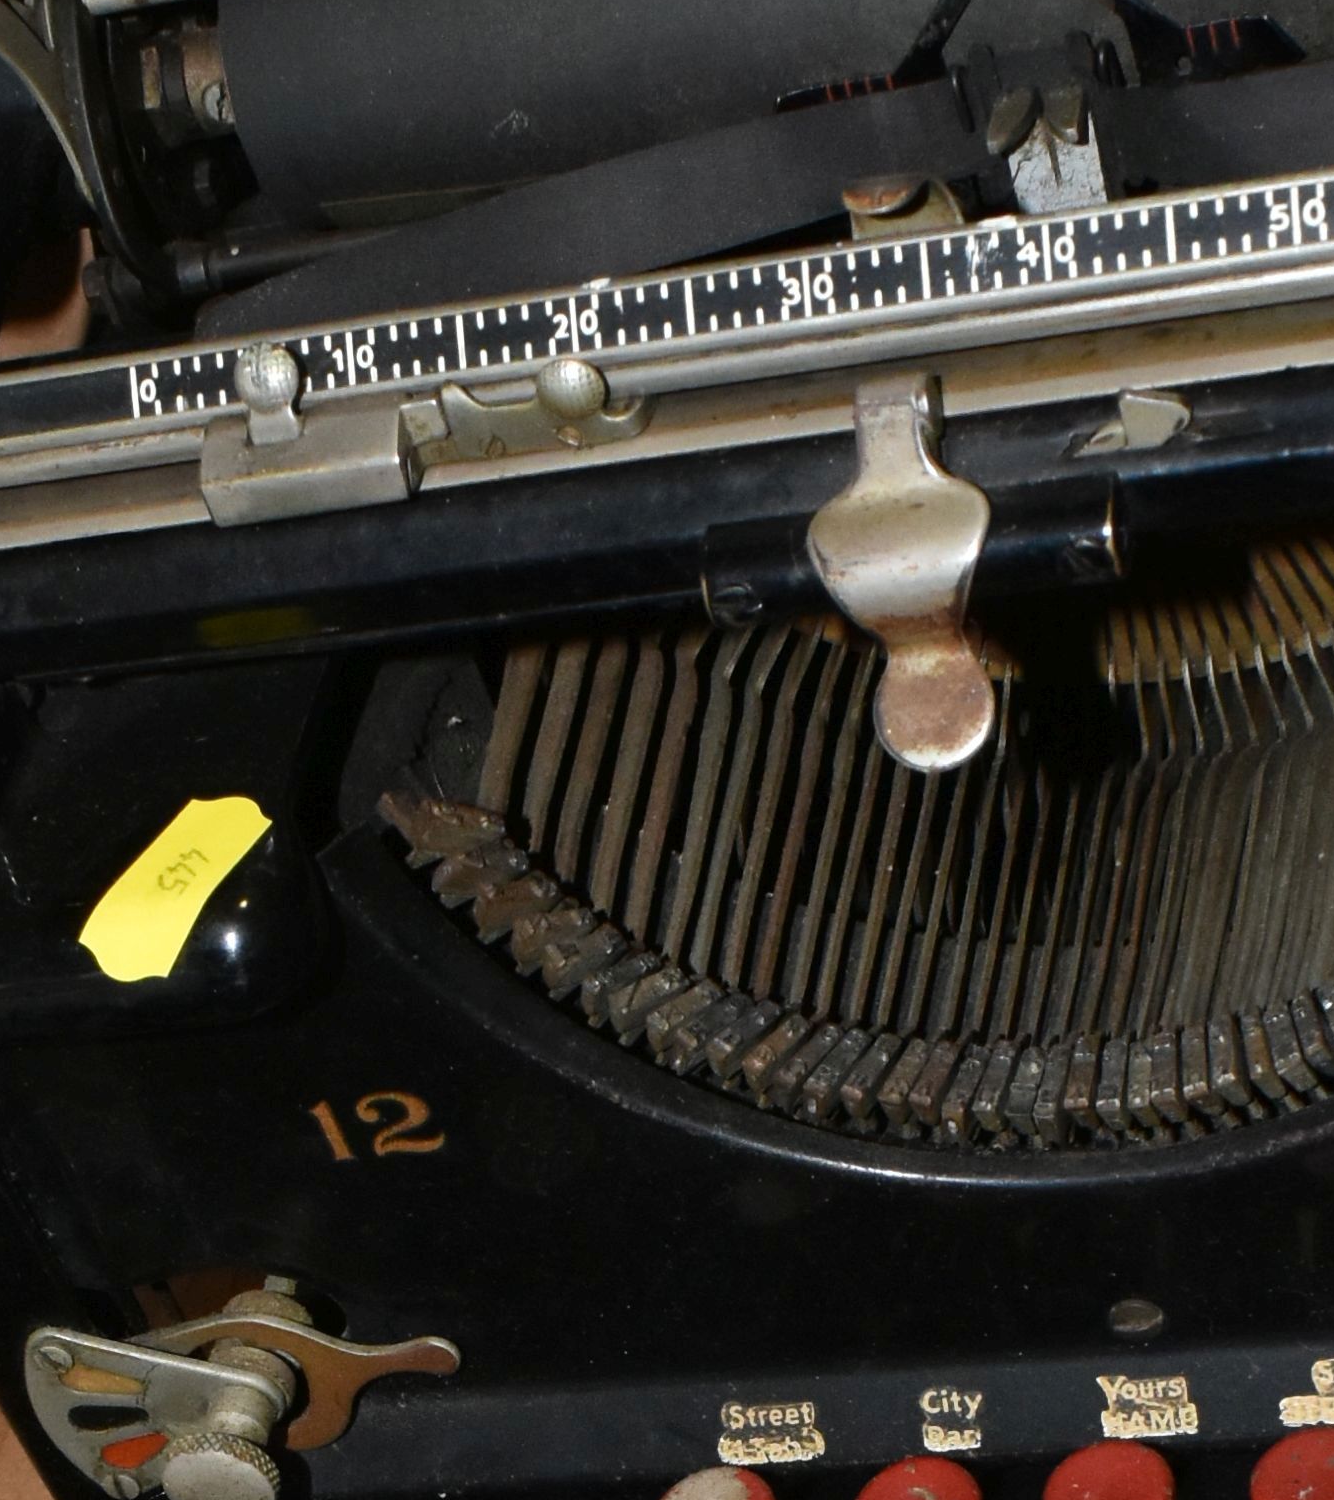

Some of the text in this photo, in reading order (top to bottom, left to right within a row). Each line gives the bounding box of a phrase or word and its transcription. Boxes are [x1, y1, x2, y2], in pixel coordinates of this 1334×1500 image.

[309, 1090, 446, 1160] 12
[1098, 1376, 1185, 1401] Yours
[727, 1403, 814, 1429] Street
[920, 1389, 983, 1419] City
